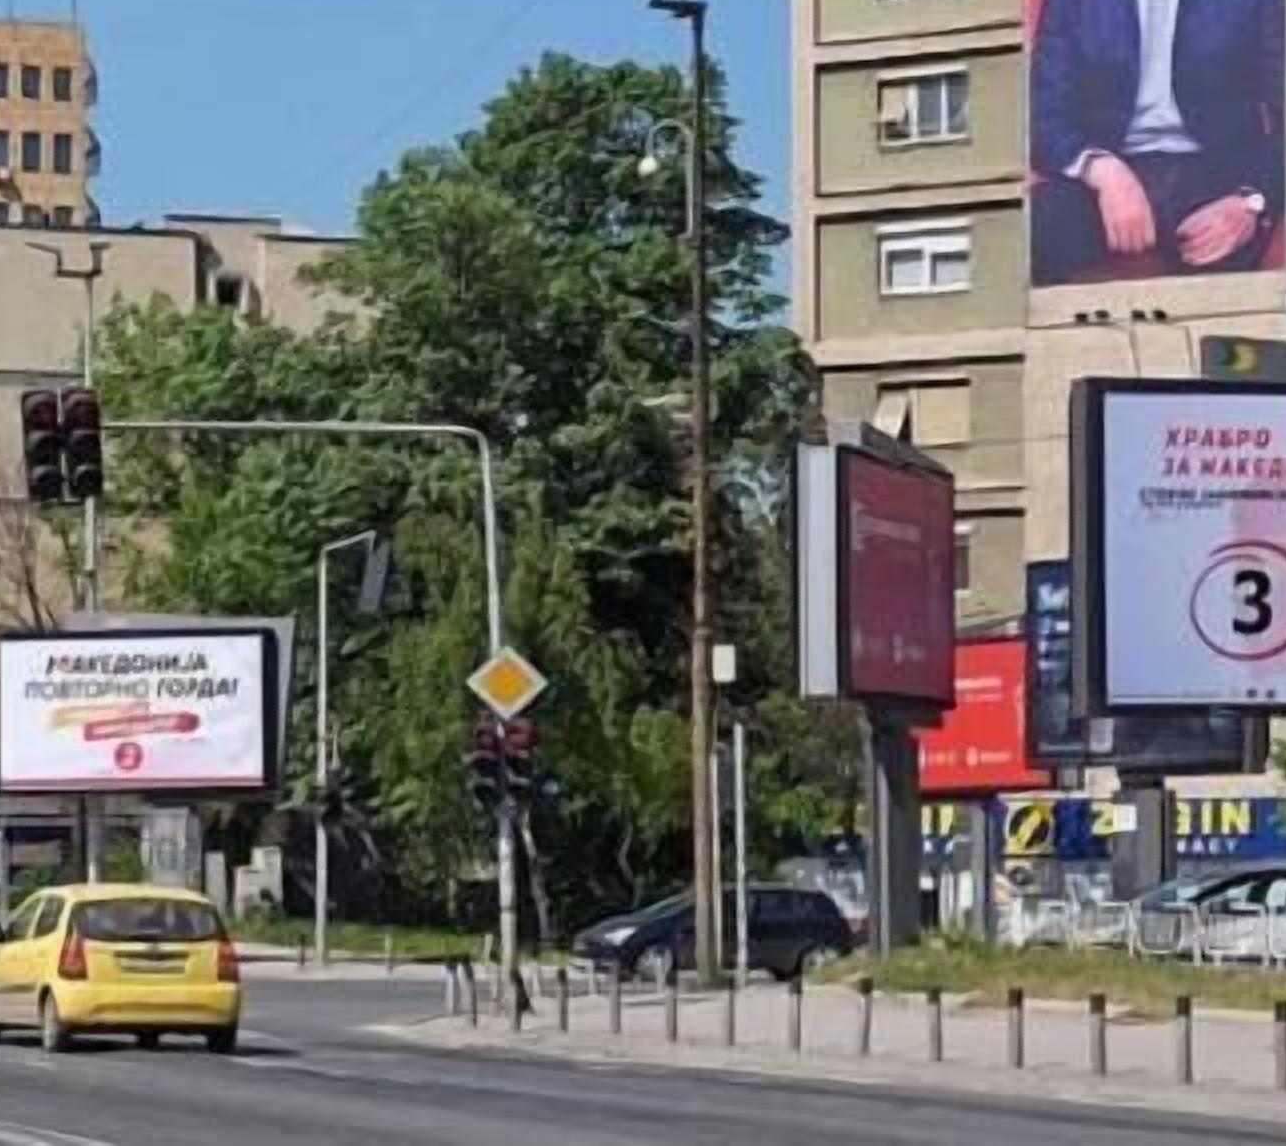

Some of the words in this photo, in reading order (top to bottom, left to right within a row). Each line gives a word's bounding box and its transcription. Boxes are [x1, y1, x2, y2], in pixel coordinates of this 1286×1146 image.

[1165, 428, 1270, 449] ХРАБРО
[1162, 457, 1191, 477] ЗА
[1231, 569, 1273, 635] 3
